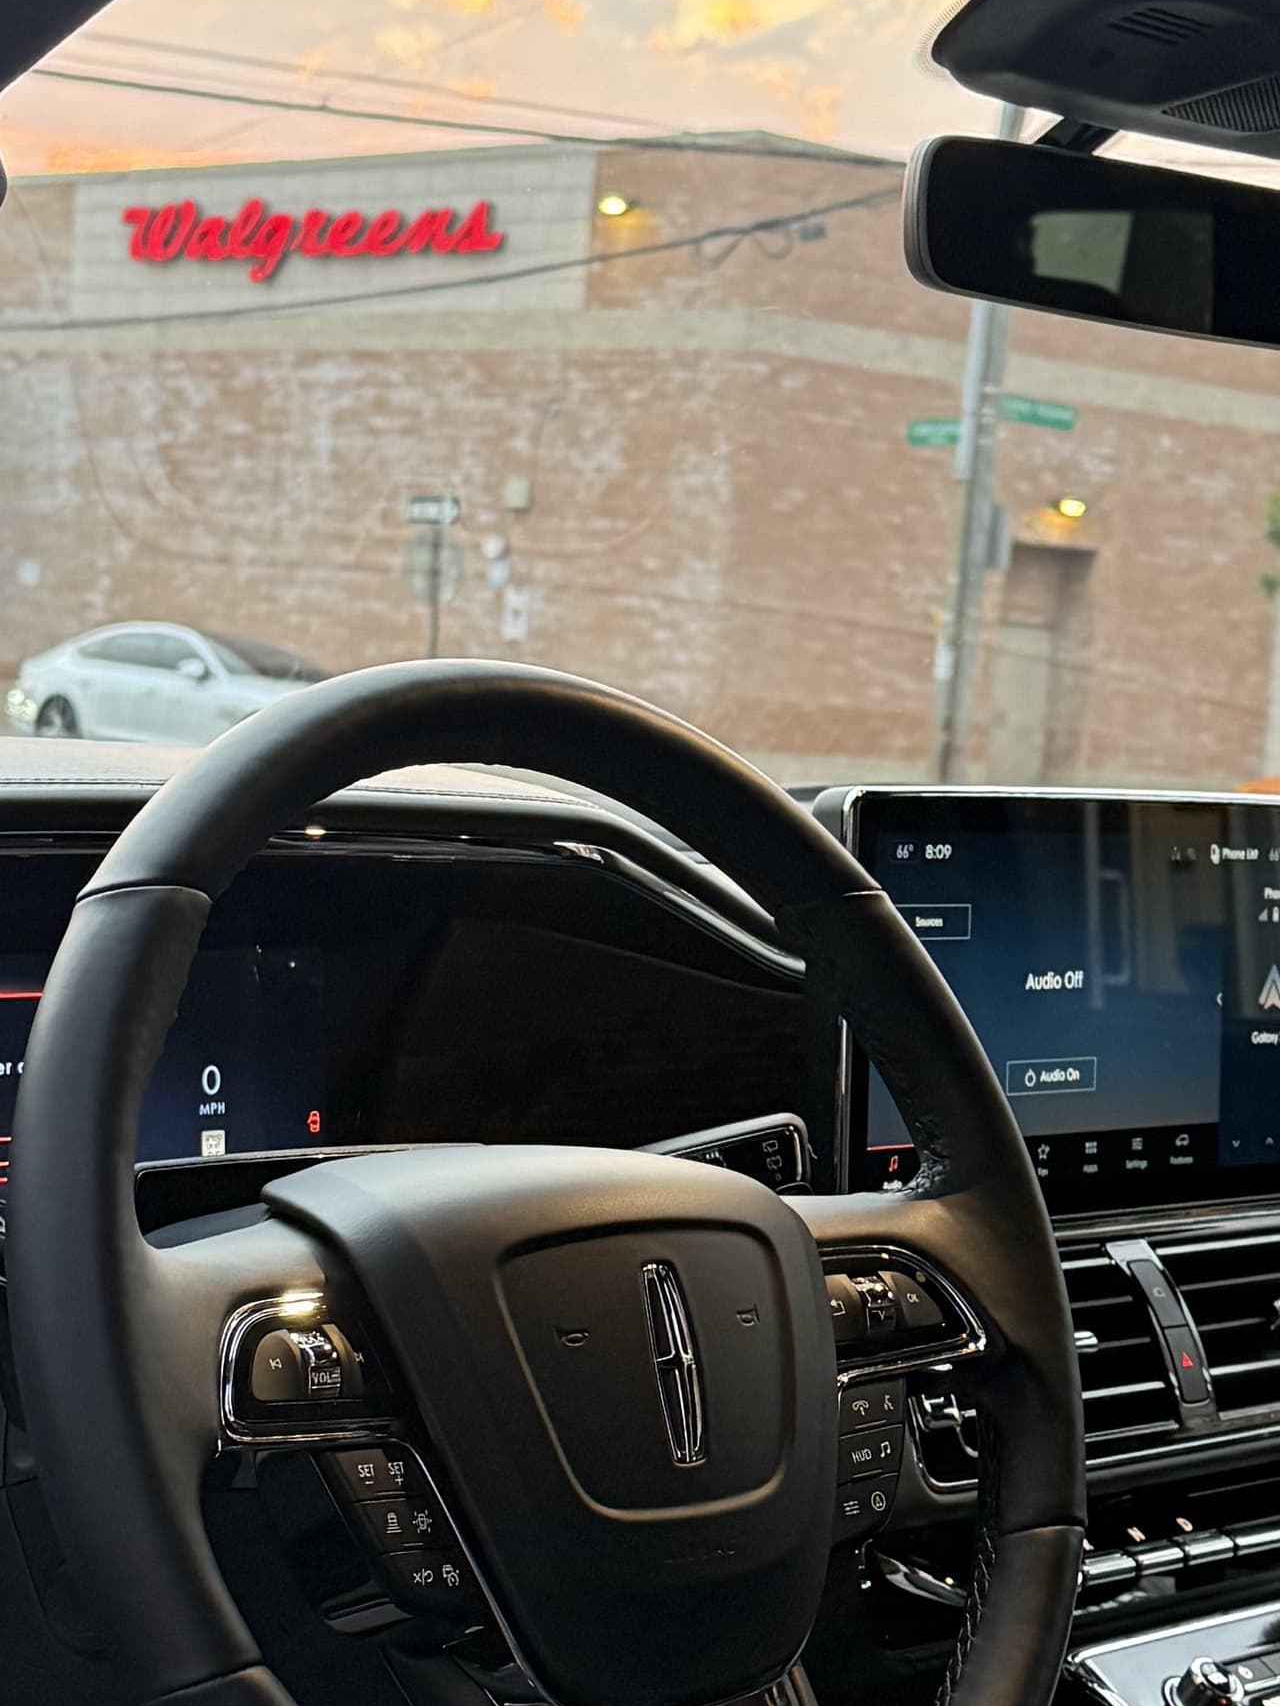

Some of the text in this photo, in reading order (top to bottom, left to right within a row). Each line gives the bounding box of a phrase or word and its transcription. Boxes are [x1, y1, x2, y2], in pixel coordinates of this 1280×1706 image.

[122, 198, 502, 283] Walgreens
[925, 844, 952, 860] 8:09
[1025, 970, 1084, 990] Audio Off
[201, 1064, 222, 1096] 0
[1039, 1067, 1080, 1083] Audio On
[198, 1100, 226, 1116] MPH
[357, 1463, 375, 1478] SET
[387, 1461, 405, 1475] SET
